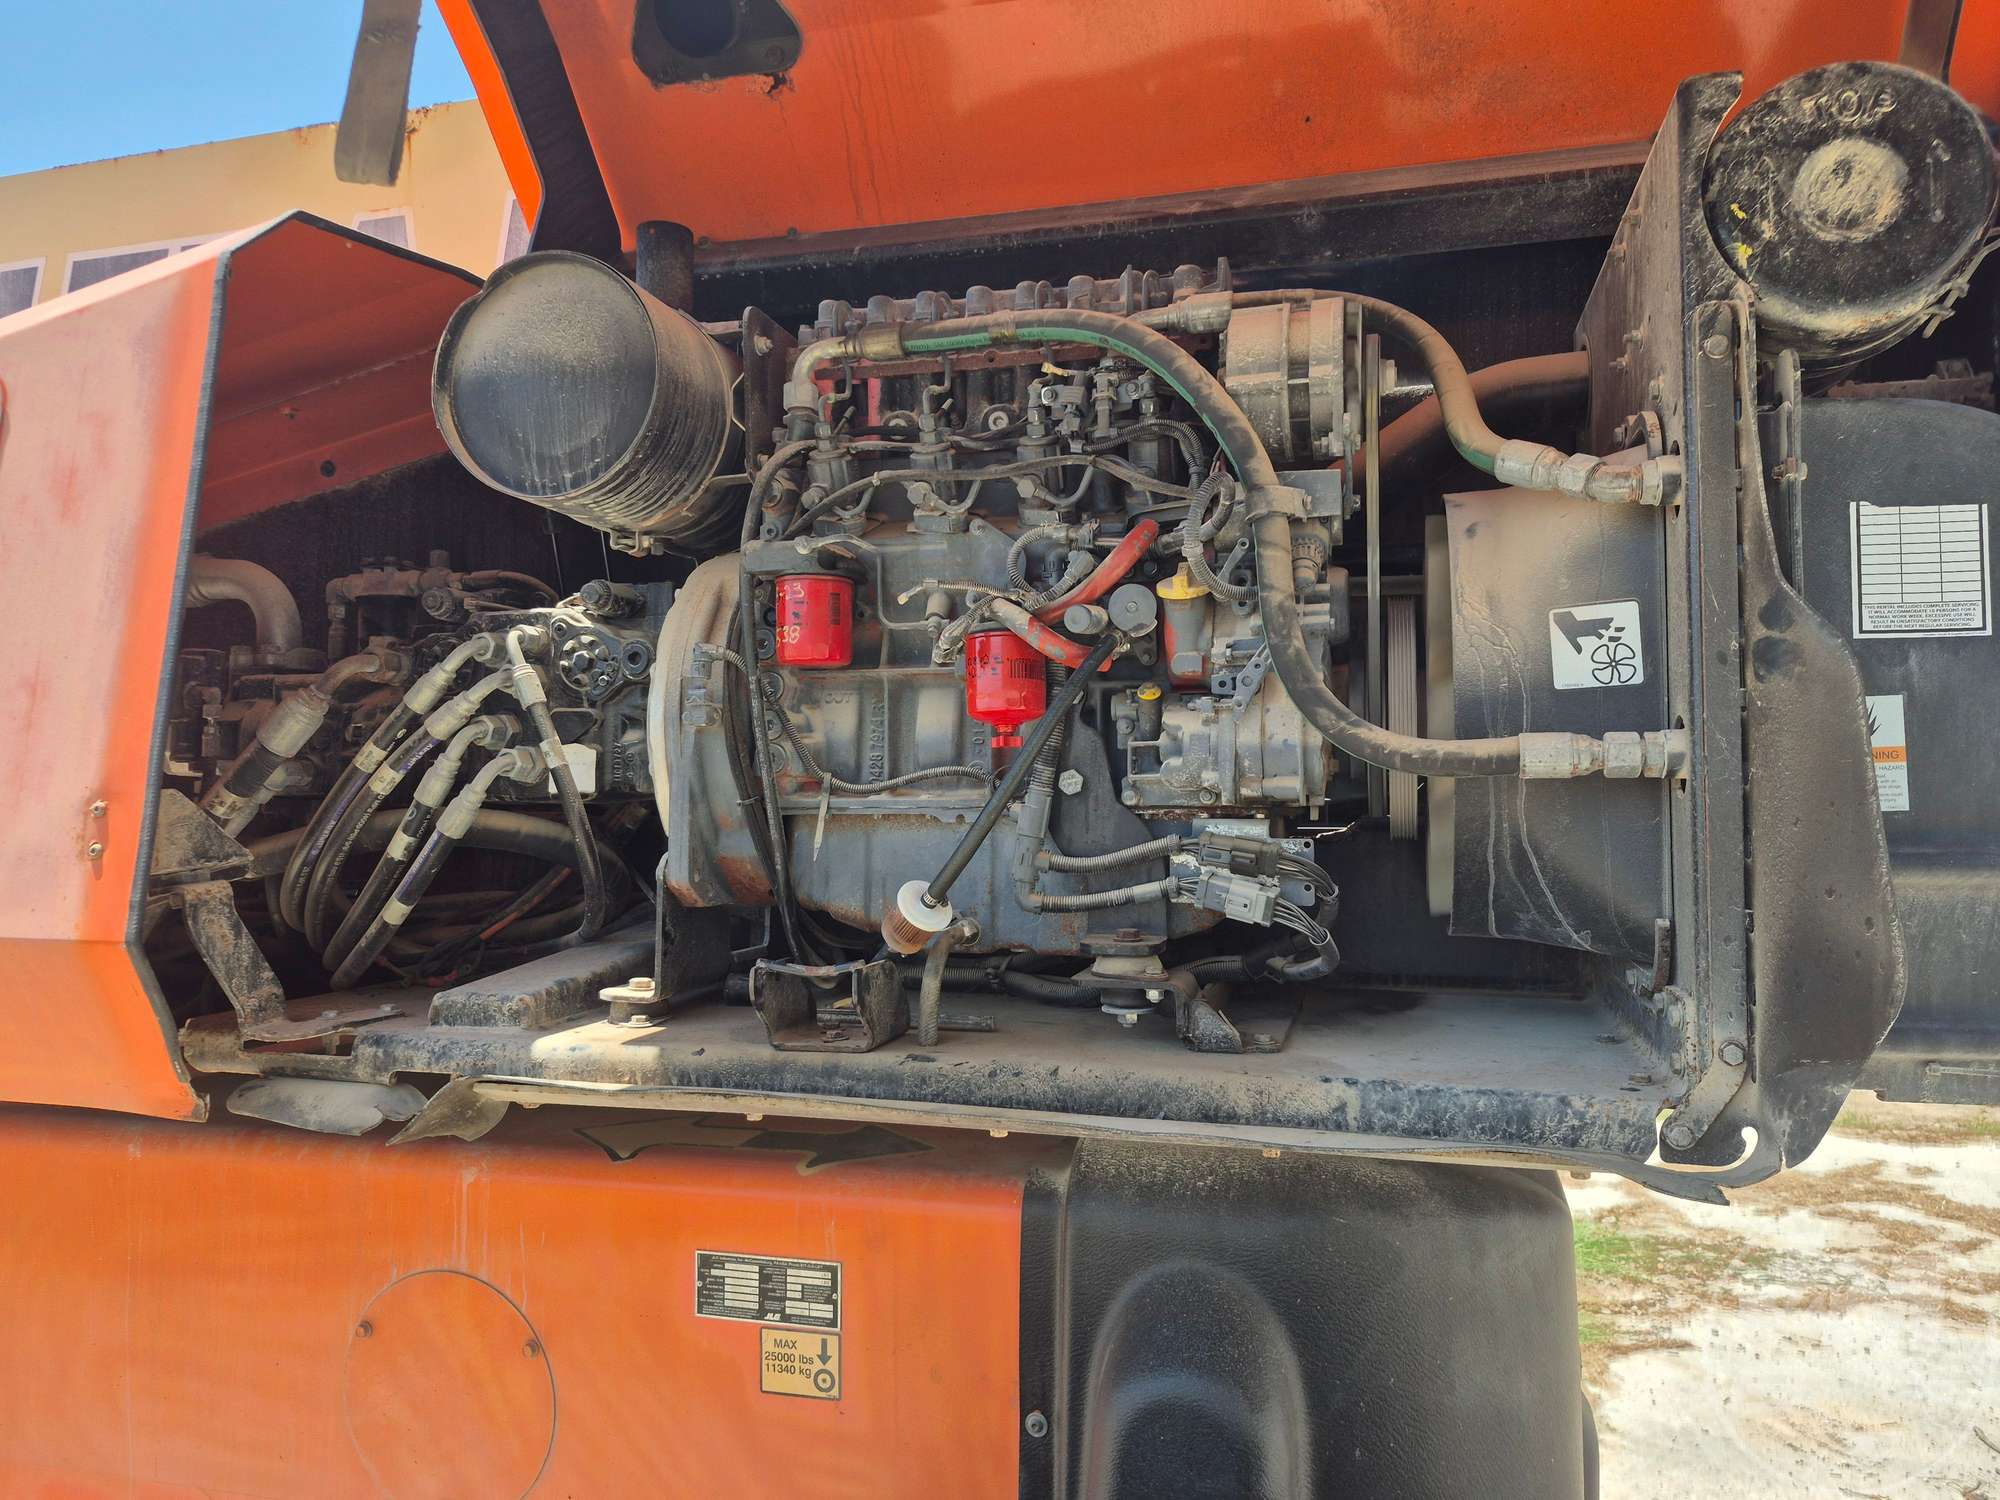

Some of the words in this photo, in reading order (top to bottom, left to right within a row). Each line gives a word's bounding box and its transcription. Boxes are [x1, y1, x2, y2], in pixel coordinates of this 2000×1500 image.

[1872, 750, 1899, 760] NING
[774, 1338, 797, 1350] MAX
[765, 1351, 795, 1363] 25000
[799, 1353, 814, 1365] lbs
[766, 1363, 796, 1375] 11340
[799, 1365, 812, 1379] kg
